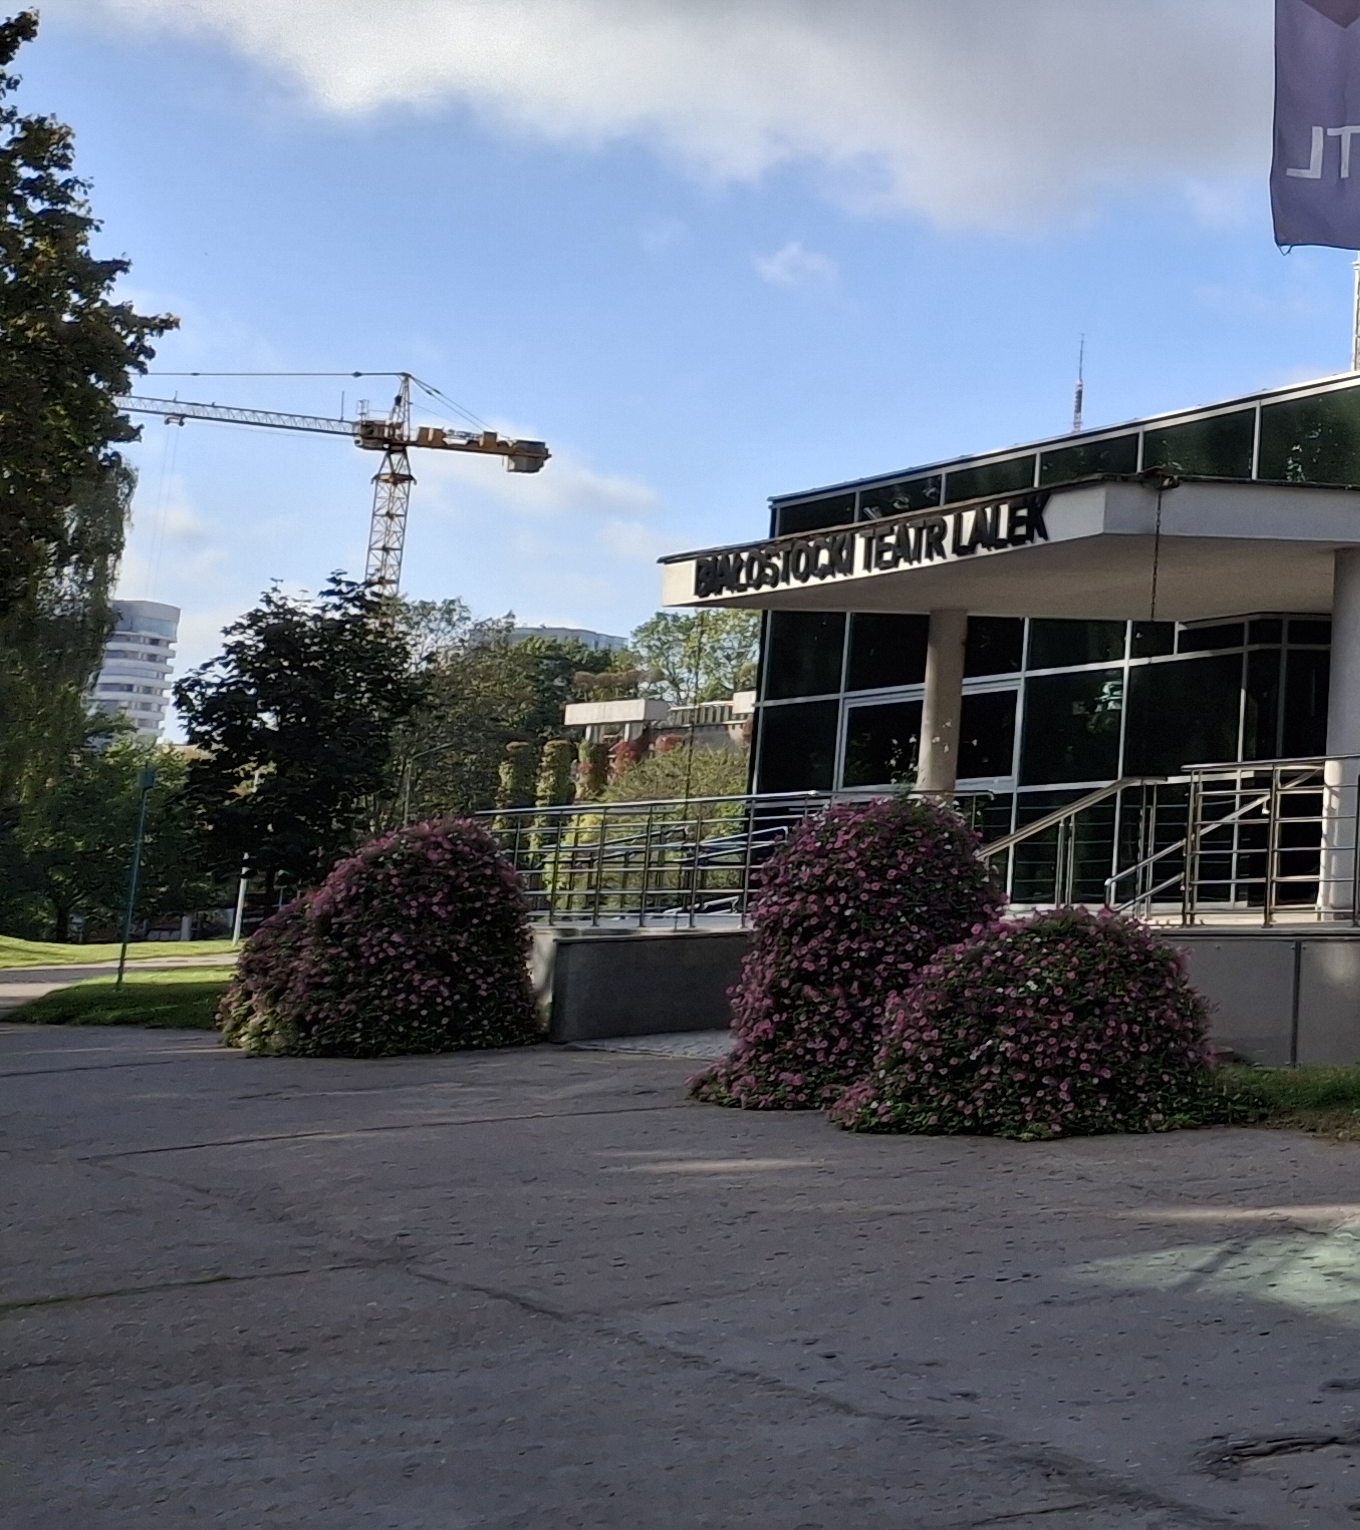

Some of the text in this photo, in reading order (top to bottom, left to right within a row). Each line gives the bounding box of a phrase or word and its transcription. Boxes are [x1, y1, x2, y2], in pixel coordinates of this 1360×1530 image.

[695, 492, 1050, 598] BIAŁOSTOCKI TEATR LALEK
